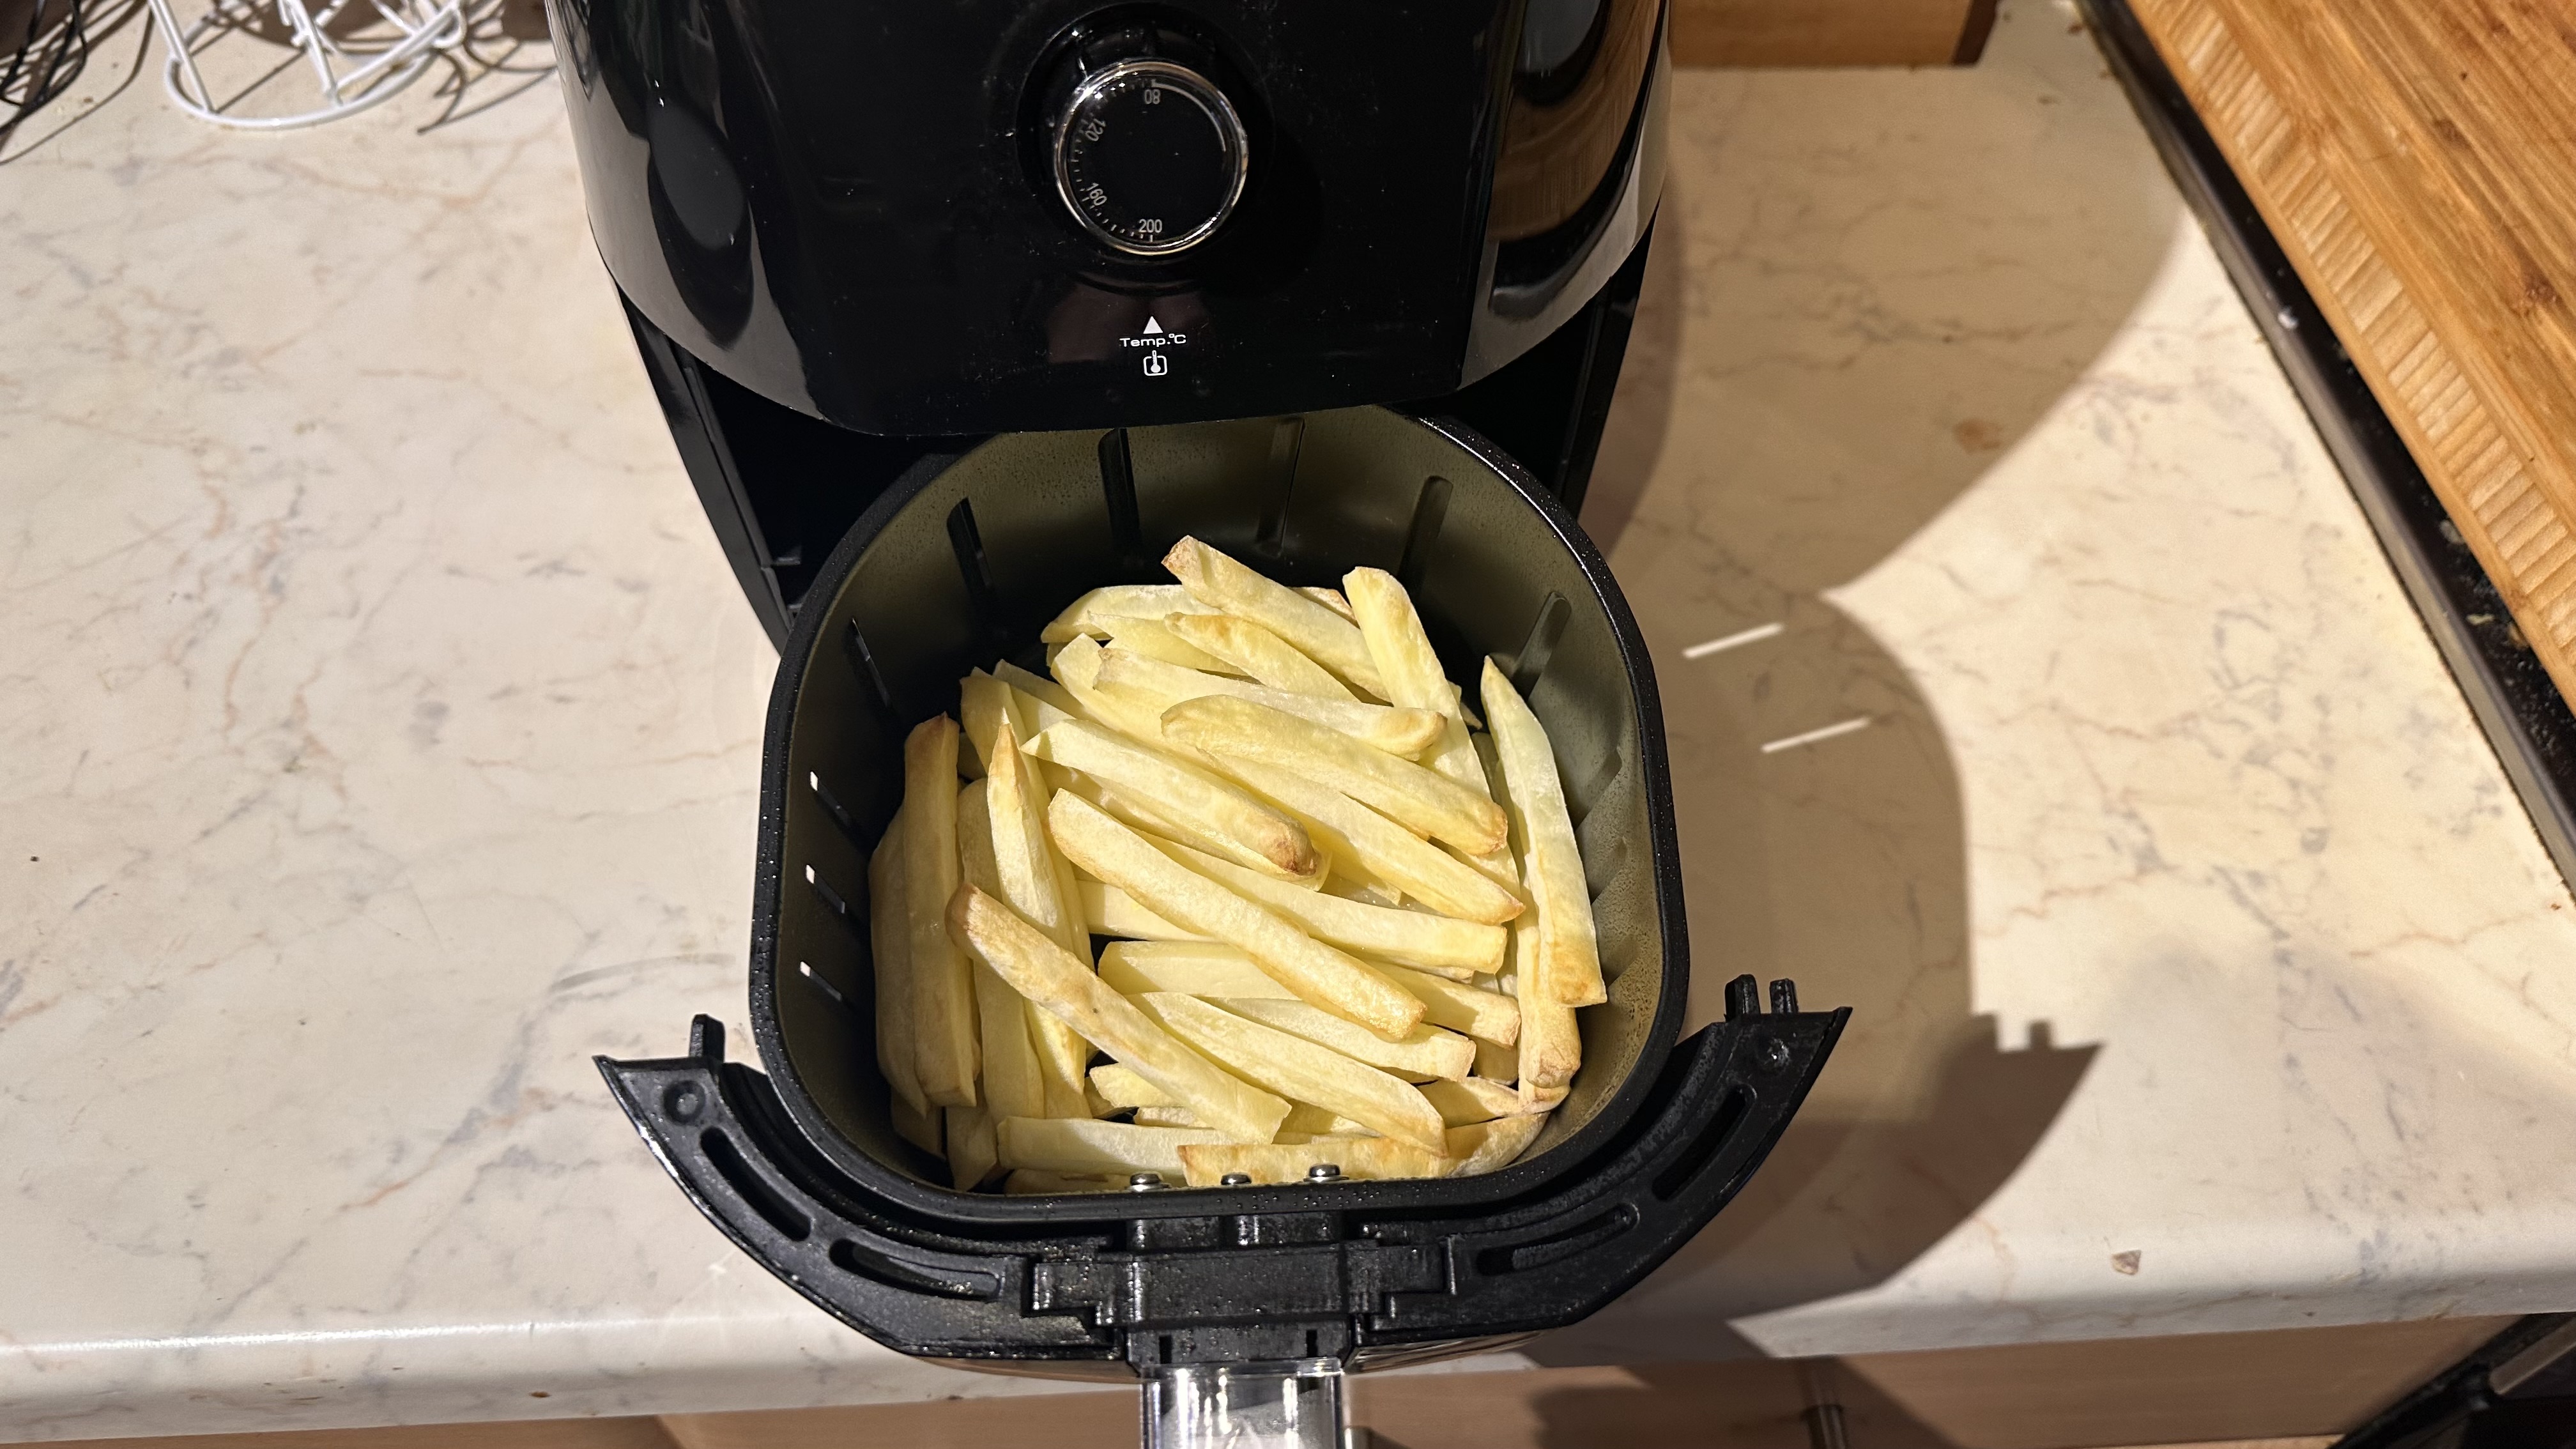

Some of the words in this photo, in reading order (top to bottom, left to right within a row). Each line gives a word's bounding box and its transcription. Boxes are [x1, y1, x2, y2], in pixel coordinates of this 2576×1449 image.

[1144, 89, 1161, 104] 80
[1085, 118, 1106, 142] 120
[1086, 182, 1107, 206] 160
[1138, 218, 1163, 234] 200
